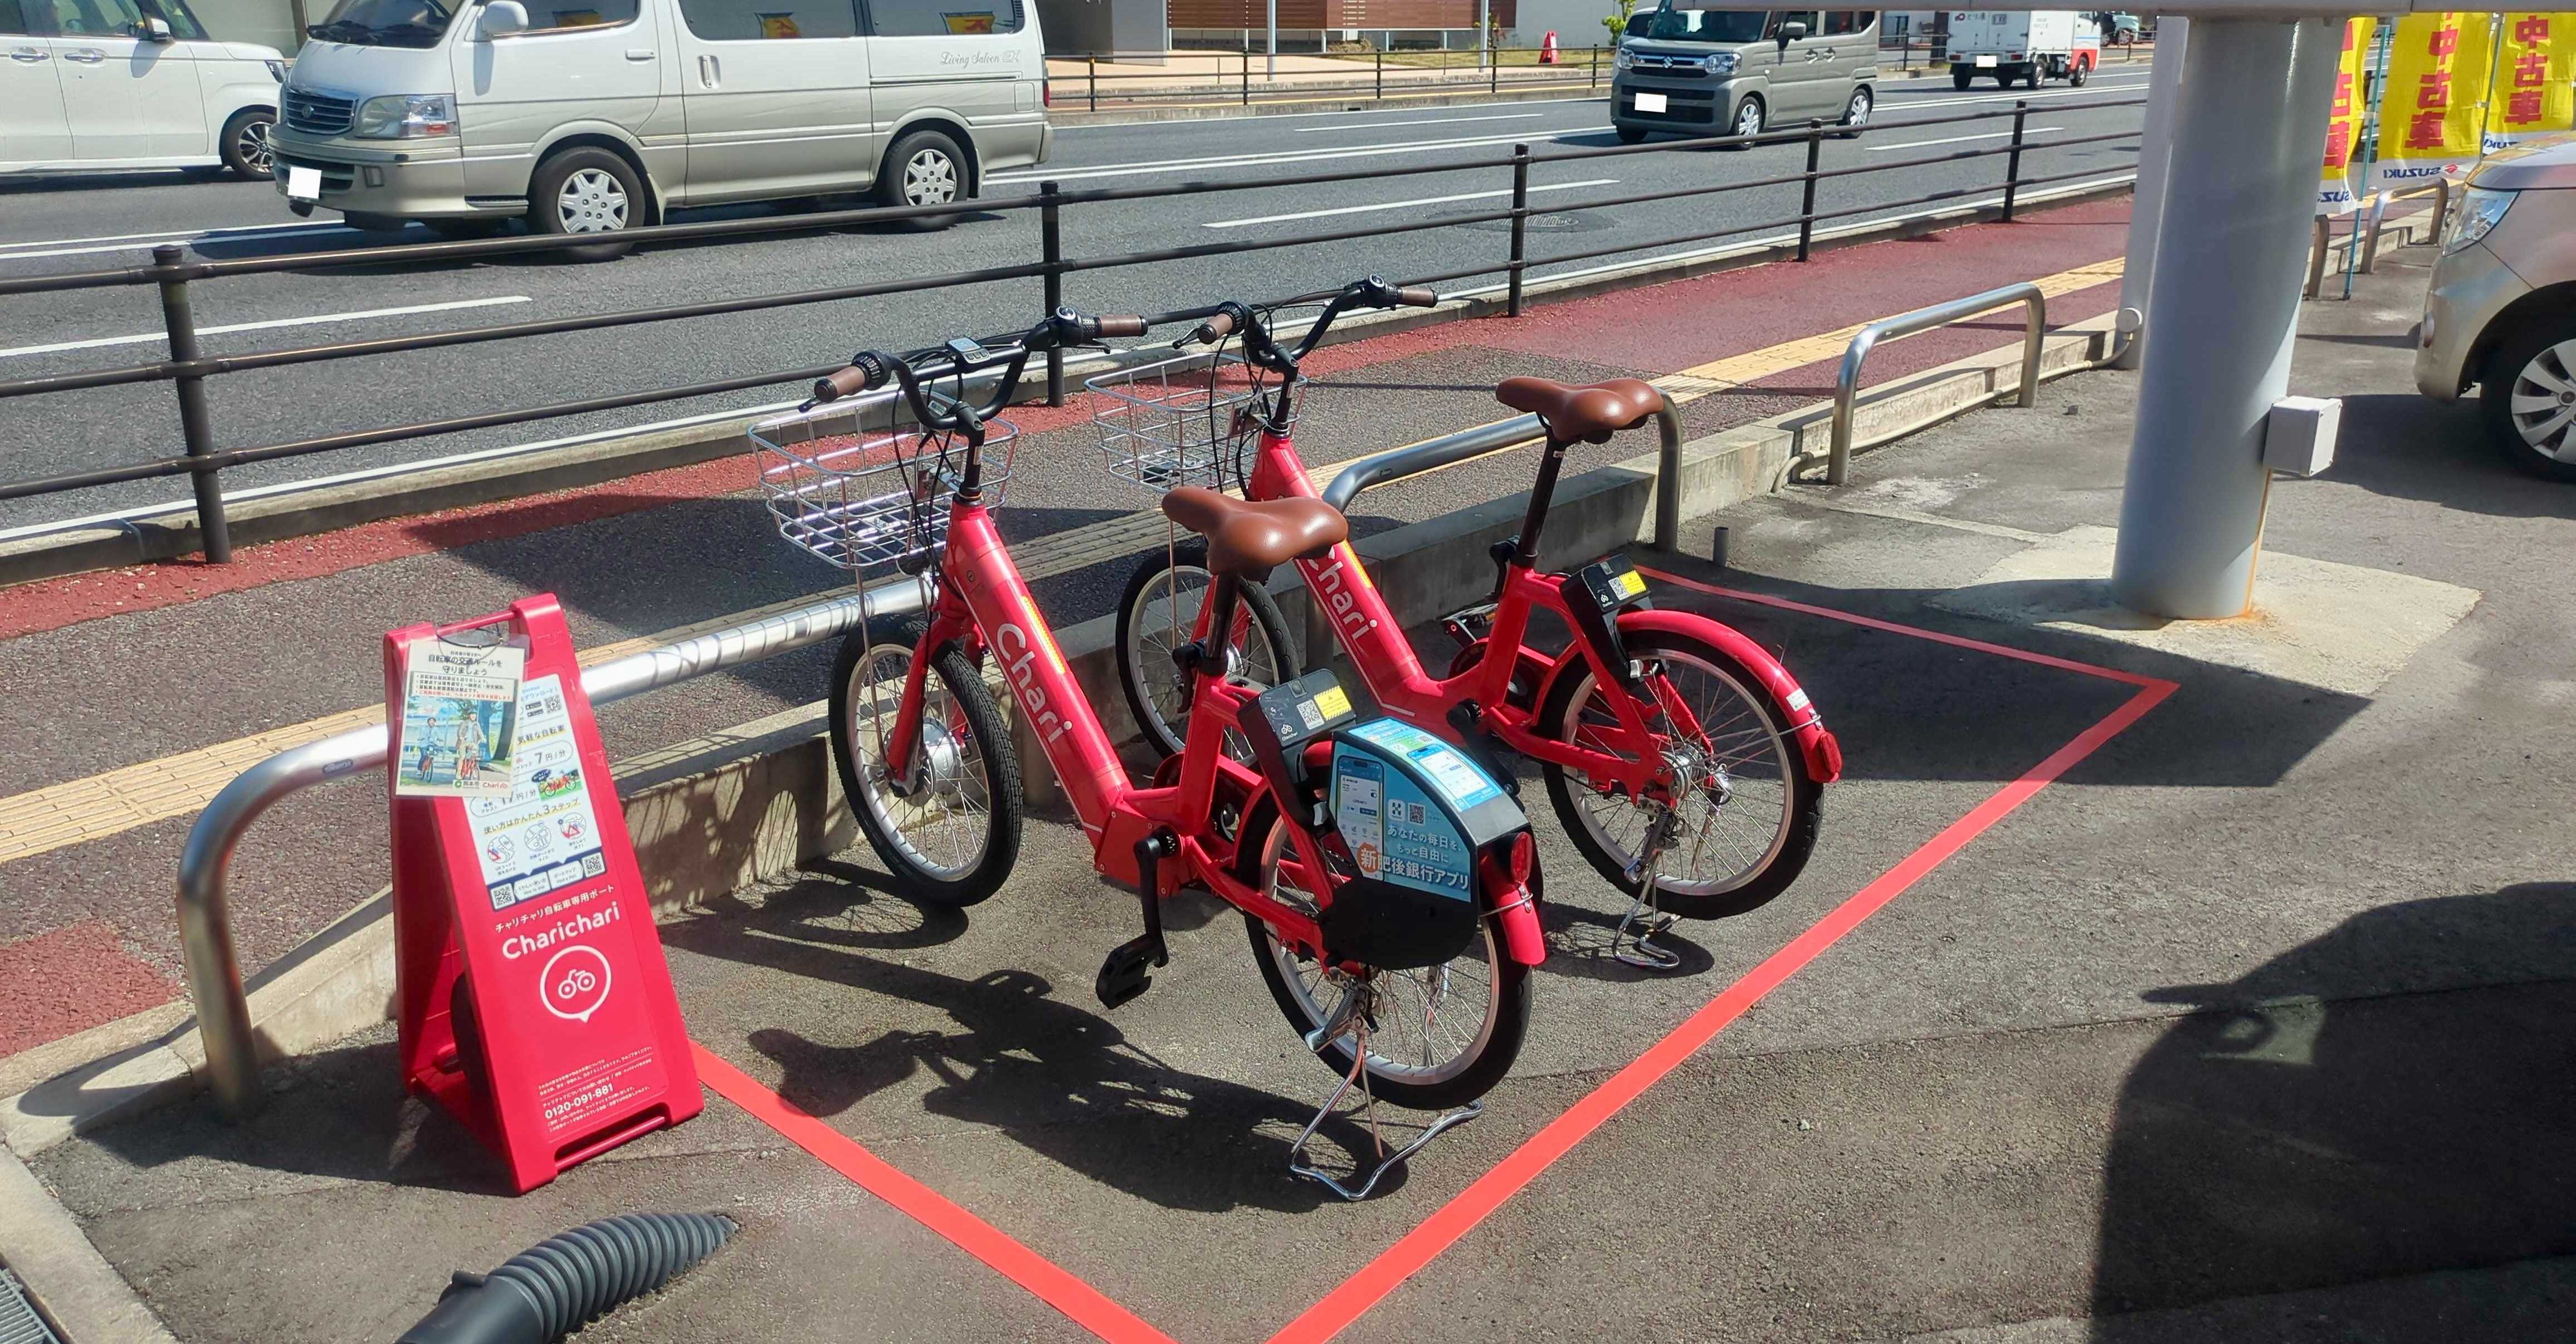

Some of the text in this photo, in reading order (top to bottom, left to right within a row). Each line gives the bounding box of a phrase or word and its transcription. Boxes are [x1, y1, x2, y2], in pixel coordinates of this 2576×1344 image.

[940, 51, 969, 69] Living
[972, 50, 999, 63] Saloon
[443, 665, 487, 676] 守りましょう
[997, 623, 1073, 744] Chari
[1388, 825, 1461, 852] あなたの毎日を、
[1397, 843, 1449, 863] もっと自由に
[1360, 847, 1469, 890] 新肥後銀行アプリ
[495, 885, 614, 933] チャリチャリ自転車専用ポート
[502, 901, 620, 960] Charichari
[545, 1083, 613, 1119] 0120-091-881
